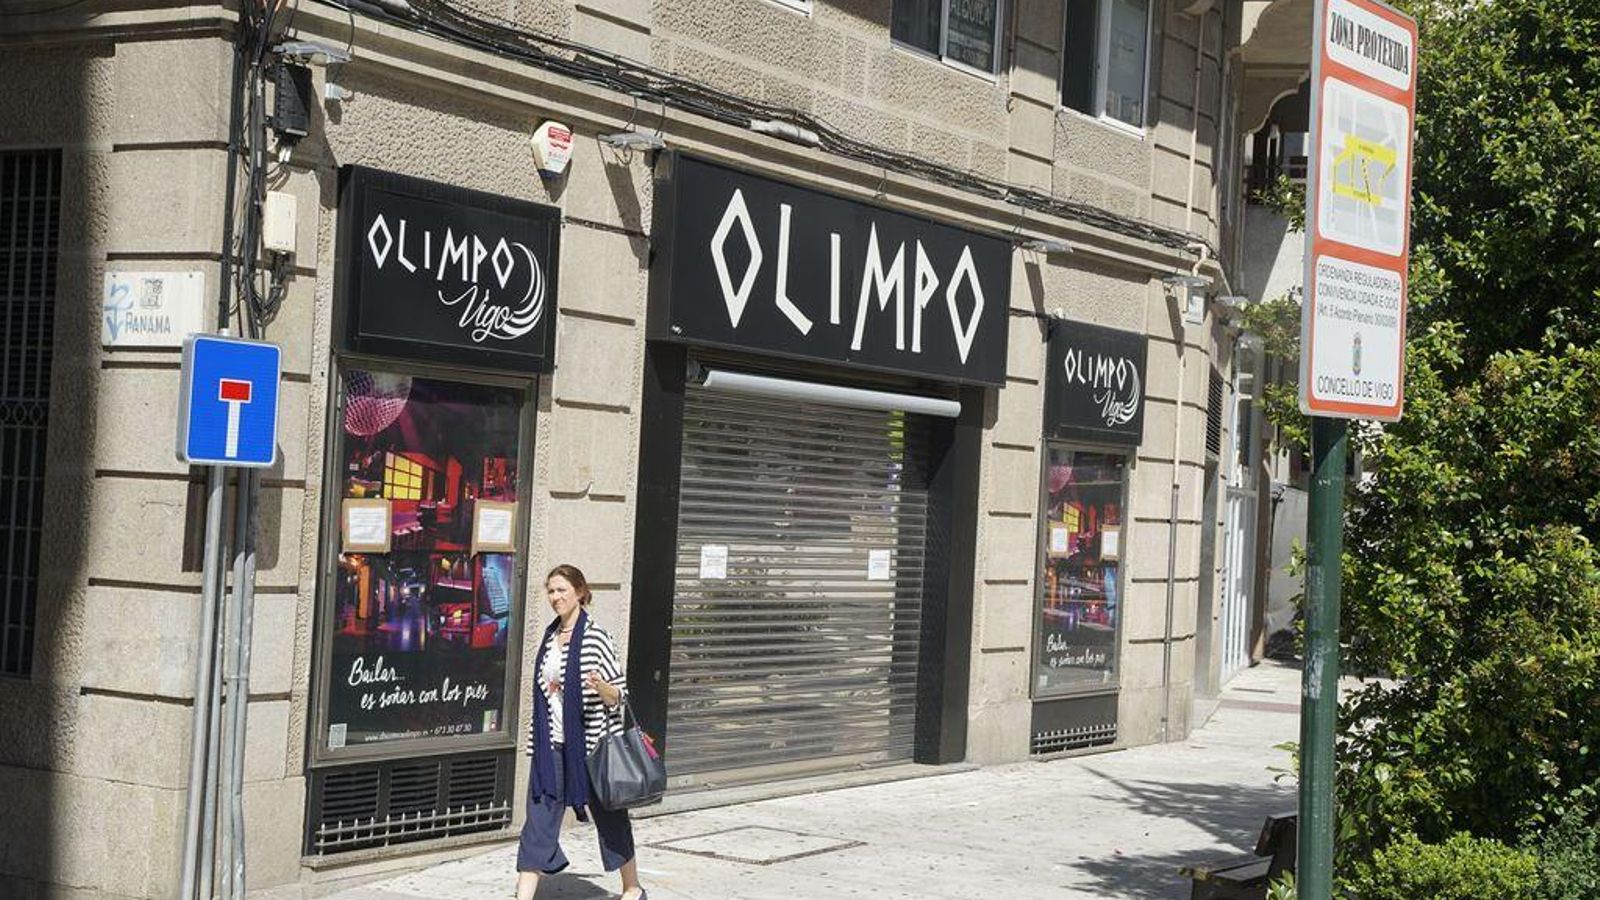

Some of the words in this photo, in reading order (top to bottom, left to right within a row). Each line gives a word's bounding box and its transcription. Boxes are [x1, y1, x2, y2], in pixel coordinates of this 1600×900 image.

[1331, 12, 1354, 51] ZONA
[1357, 24, 1408, 75] PROTEXIDA
[367, 213, 515, 289] OLIMPO
[710, 188, 985, 365] OLIMPO
[438, 285, 514, 342] Vigo
[1064, 347, 1127, 392] OLIMPO
[1317, 375, 1361, 397] CONCELLO
[1362, 380, 1373, 398] DE
[1374, 381, 1394, 401] VIGO
[1093, 389, 1125, 427] Vigo
[360, 692, 377, 710] es
[379, 685, 417, 710] soñar
[418, 688, 438, 704] con
[441, 676, 461, 702] los
[462, 681, 489, 708] pies
